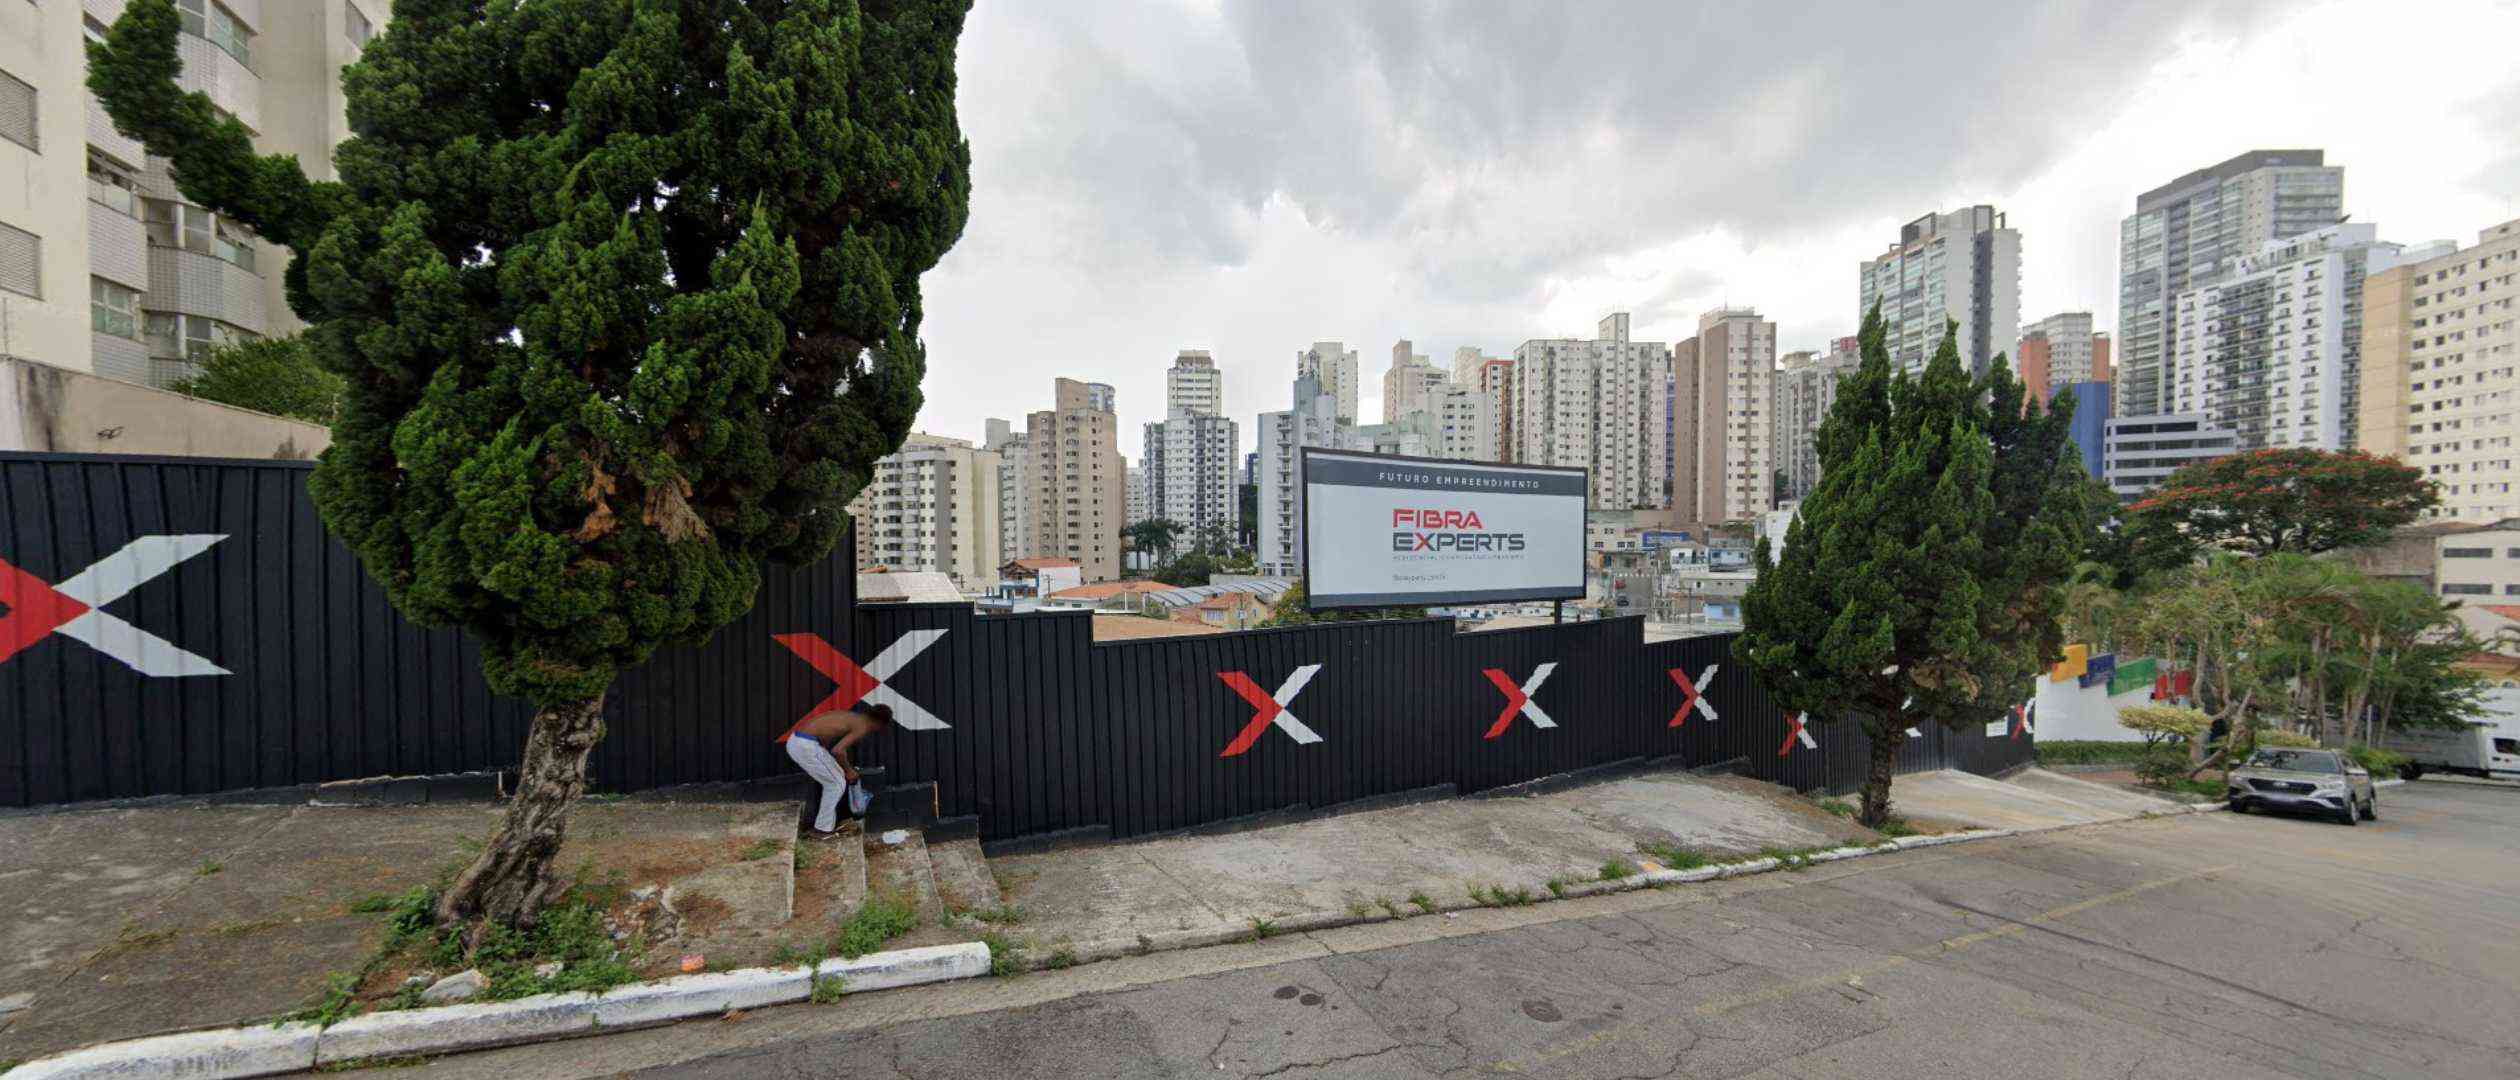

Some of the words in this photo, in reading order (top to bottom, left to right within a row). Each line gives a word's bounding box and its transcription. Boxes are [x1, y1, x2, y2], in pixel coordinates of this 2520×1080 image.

[1378, 472, 1429, 484] FUTURO
[1436, 475, 1540, 489] EMPREENDIMENTO
[1392, 508, 1483, 530] FIBRA
[1392, 532, 1526, 552] EXPERTS
